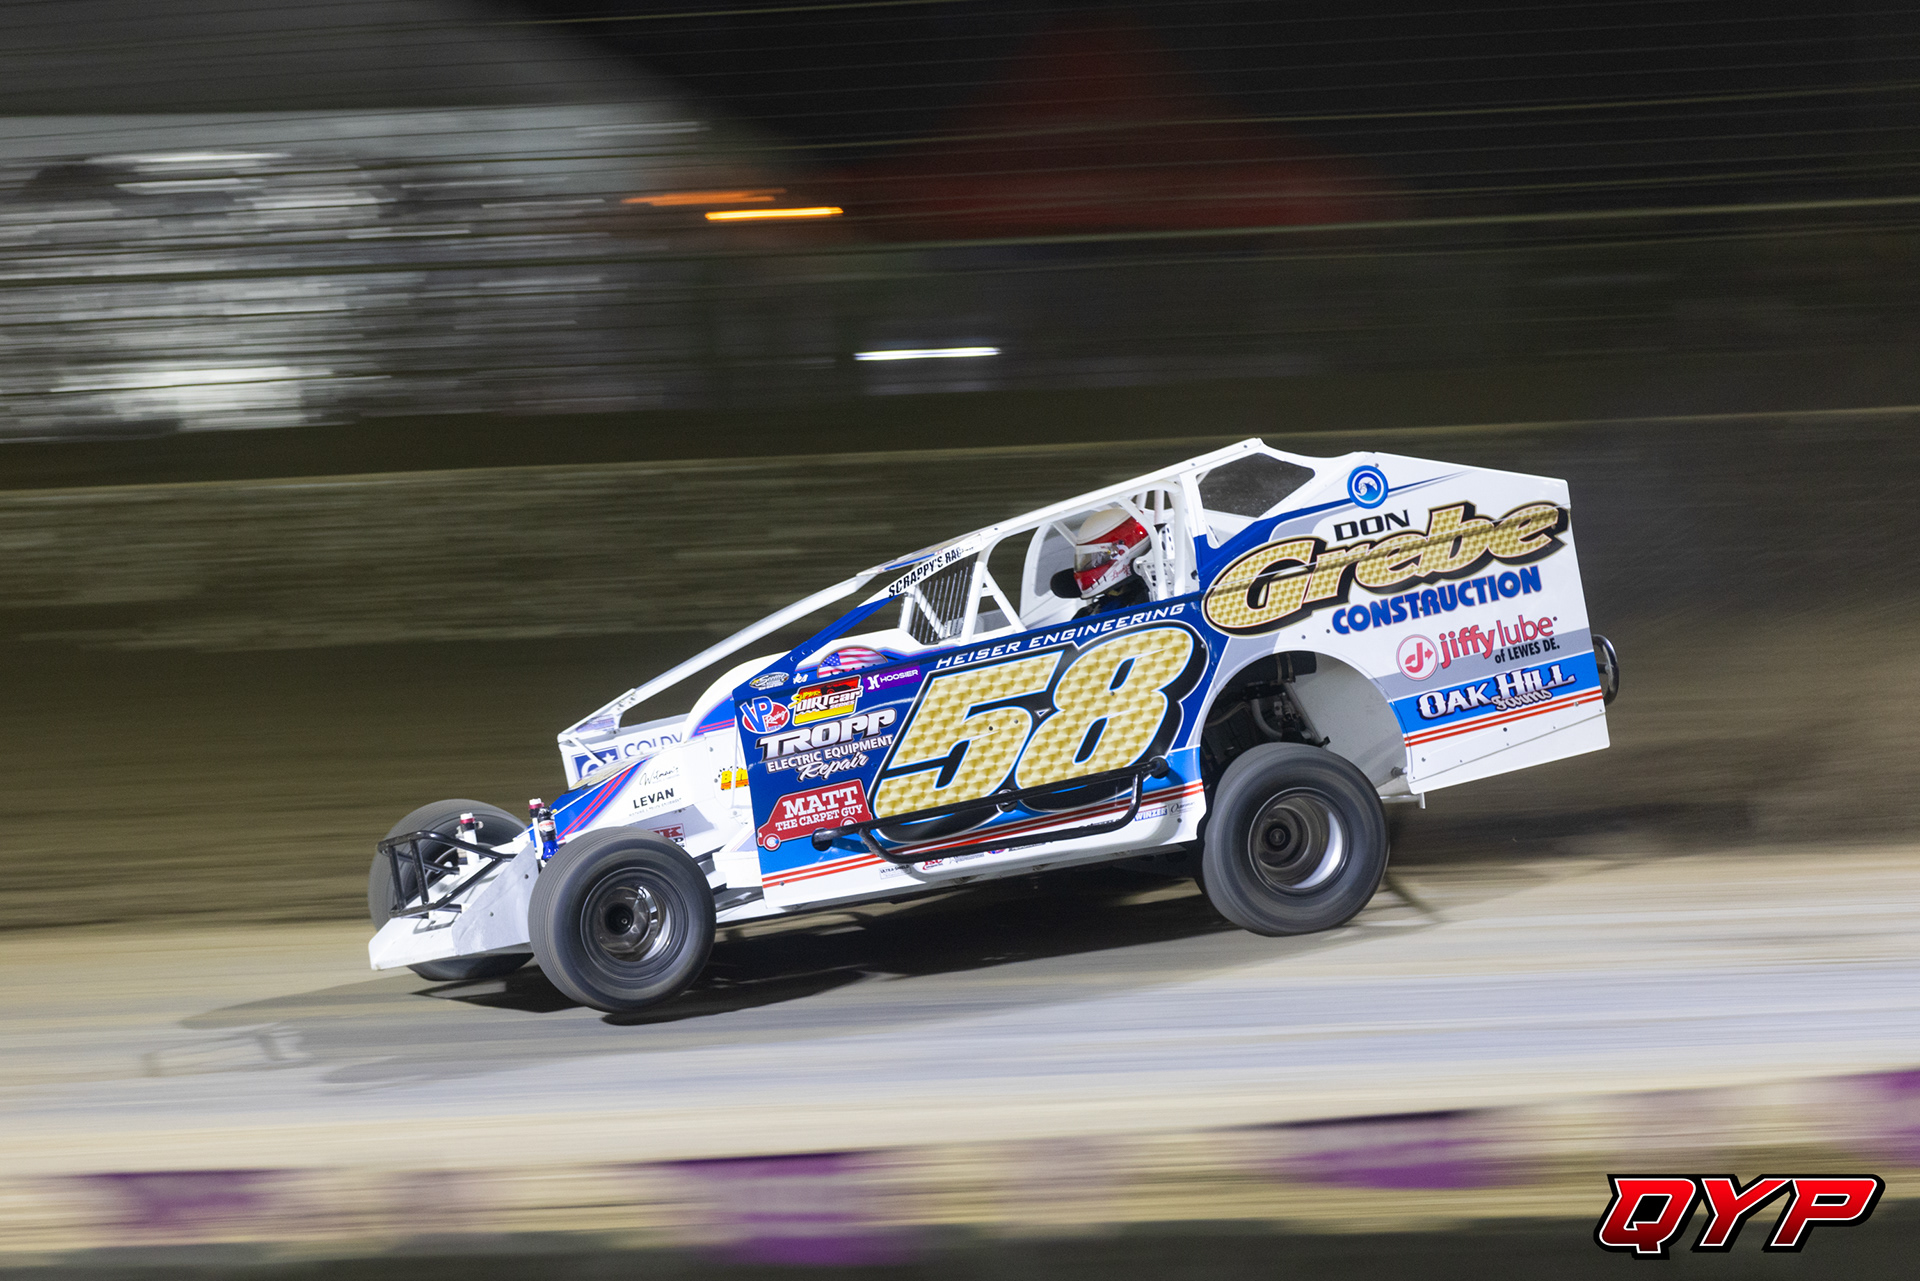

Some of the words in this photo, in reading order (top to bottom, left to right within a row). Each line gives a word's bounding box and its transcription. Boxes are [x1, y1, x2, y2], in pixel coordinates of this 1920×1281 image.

[1333, 509, 1410, 541] DON
[888, 555, 943, 598] SCRAPPY'S
[1203, 502, 1566, 633] Grebe
[1331, 565, 1543, 636] CONSTRUCTION
[936, 640, 1021, 670] HEISER
[1028, 603, 1186, 649] ENGINEERING
[1438, 624, 1496, 669] jiffy
[1495, 614, 1554, 647] lube
[1495, 648, 1506, 664] of
[1508, 641, 1541, 661] LEWES
[1544, 637, 1560, 652] DE.
[879, 669, 919, 682] HOOSIER
[1417, 682, 1494, 720] OAK
[1493, 663, 1577, 700] HILL
[739, 695, 772, 732] VP
[1490, 688, 1553, 711] Farms
[757, 708, 896, 761] TROPP
[765, 710, 788, 727] Racing
[870, 623, 1199, 824] 58
[767, 751, 823, 774] ELECTRIC
[825, 734, 894, 761] EQUIPMENT
[797, 752, 869, 781] Repair
[633, 787, 675, 809] LEVAN
[782, 786, 858, 819] MATT
[1135, 807, 1167, 821] WINZER
[775, 818, 798, 831] THE
[799, 811, 840, 827] CARPET
[841, 804, 863, 817] GUY
